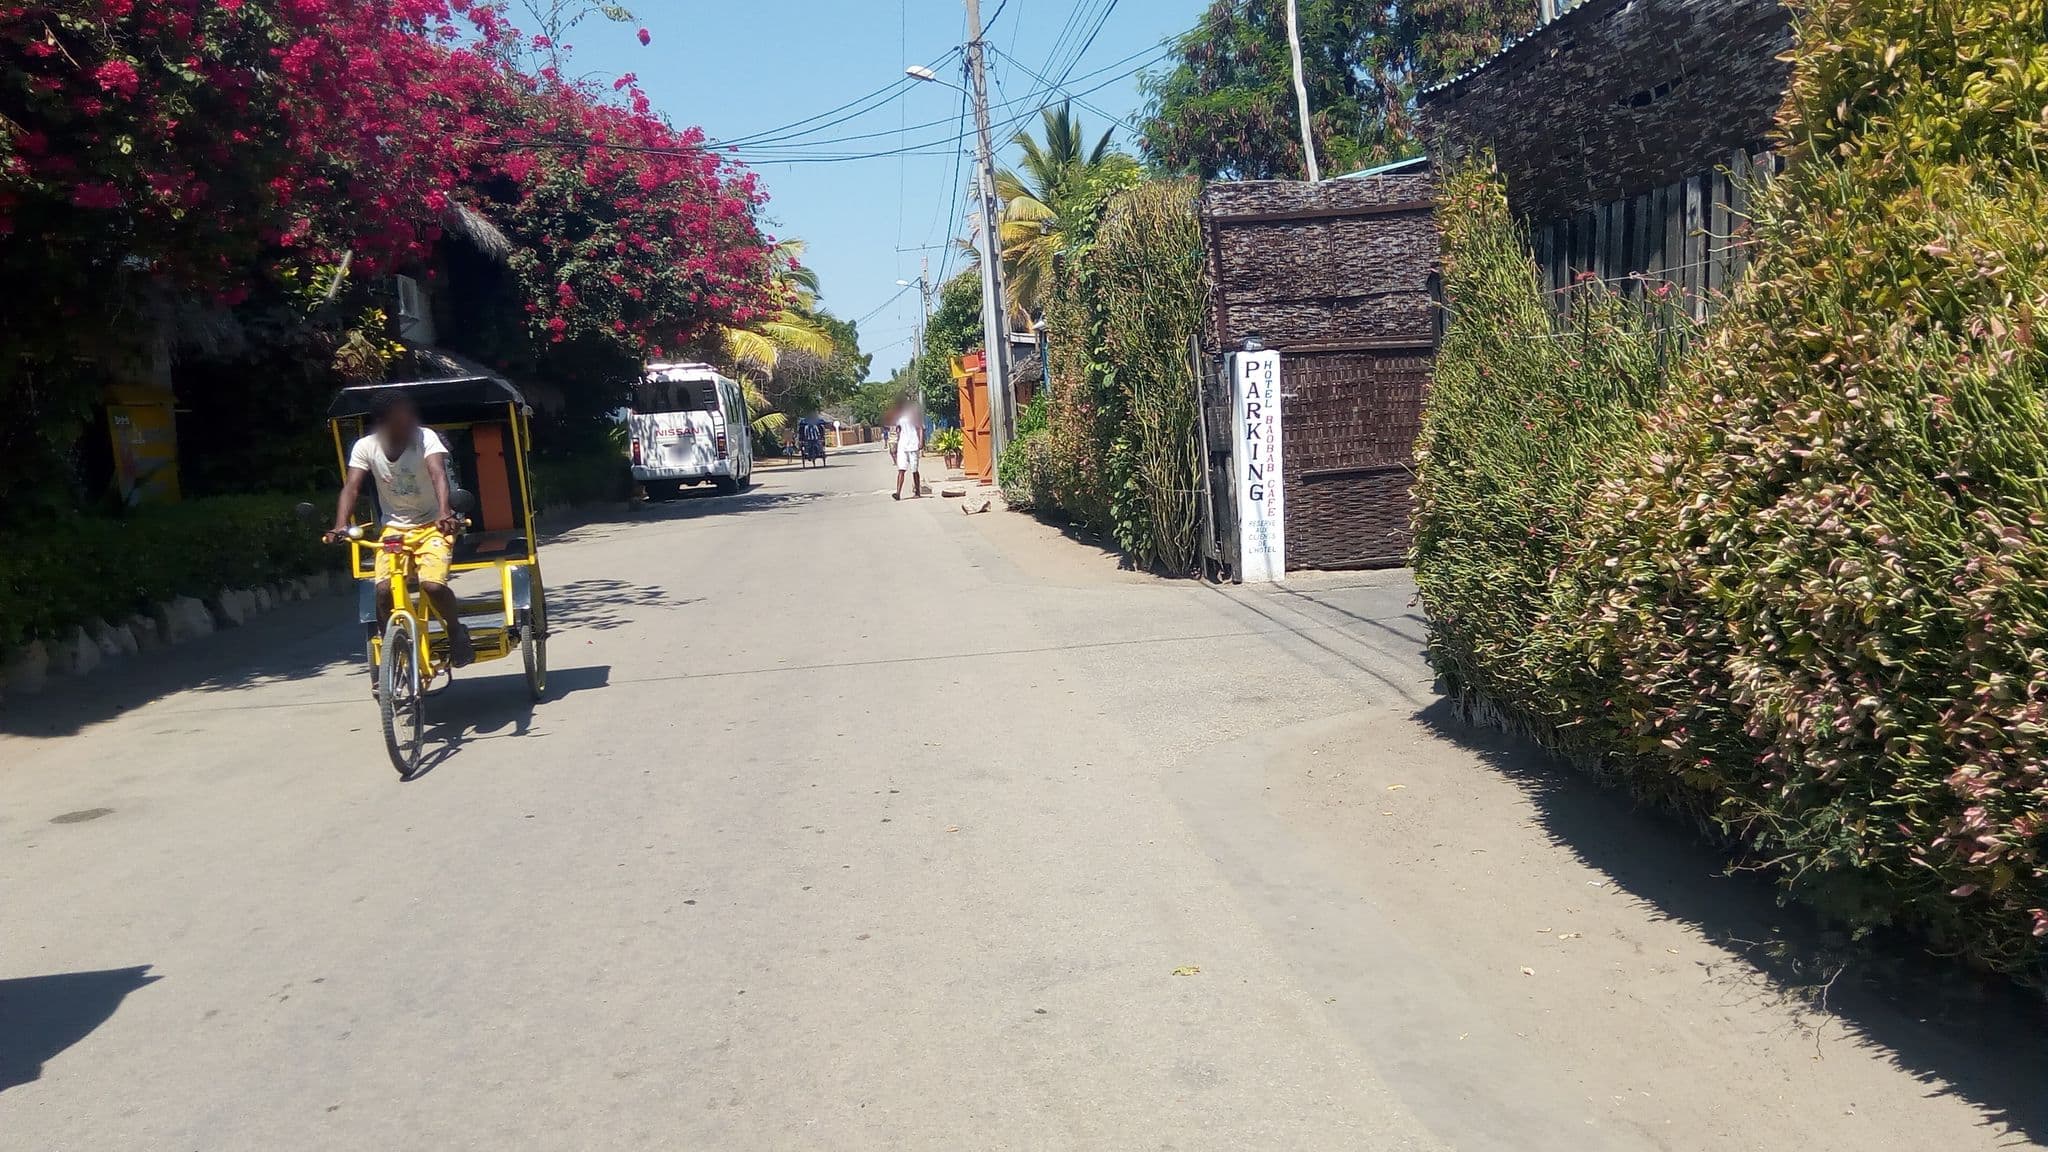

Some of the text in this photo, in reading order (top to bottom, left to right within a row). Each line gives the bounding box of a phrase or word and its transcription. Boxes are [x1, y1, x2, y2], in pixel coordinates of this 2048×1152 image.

[1264, 361, 1273, 408] HOTEL
[655, 427, 700, 437] NISSAN
[1245, 361, 1264, 501] PARKING
[1266, 416, 1275, 472] BAOBAB
